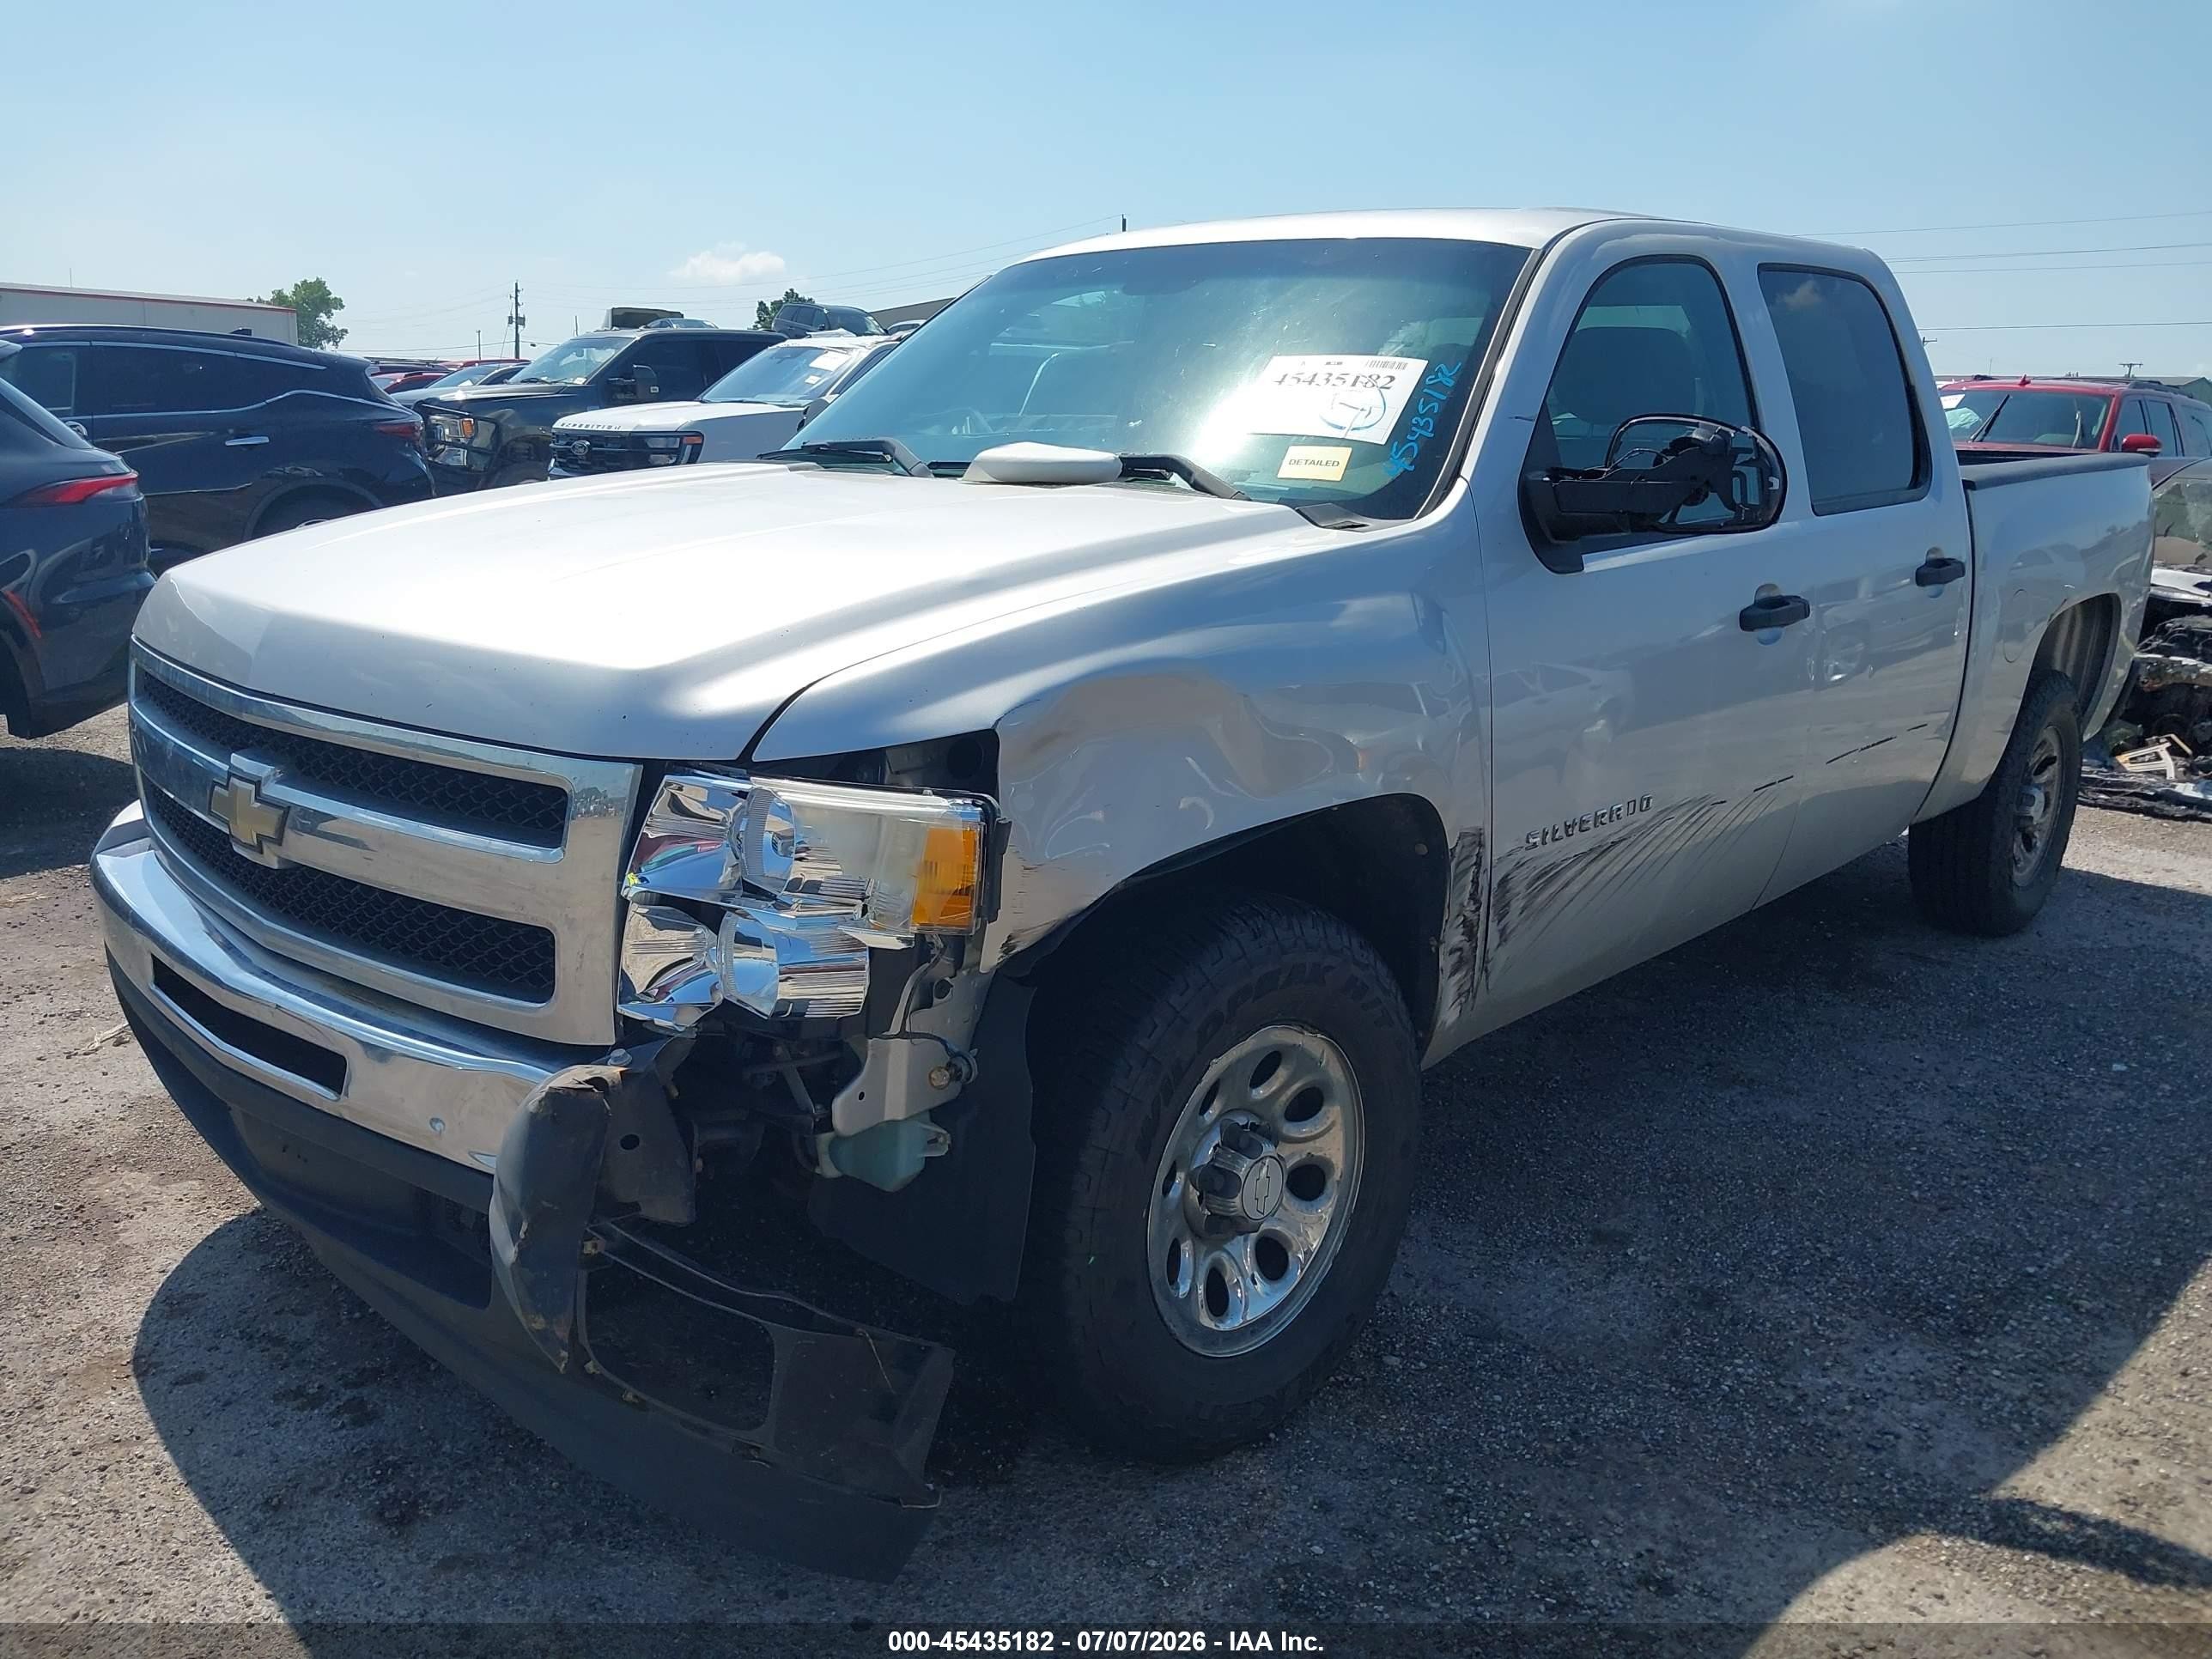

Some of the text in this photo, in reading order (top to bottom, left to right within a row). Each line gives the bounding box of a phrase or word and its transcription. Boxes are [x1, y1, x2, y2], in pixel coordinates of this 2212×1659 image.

[1273, 372, 1396, 390] 45435182
[1288, 458, 1340, 468] DETAILED
[1524, 793, 1654, 851] SILVERADO
